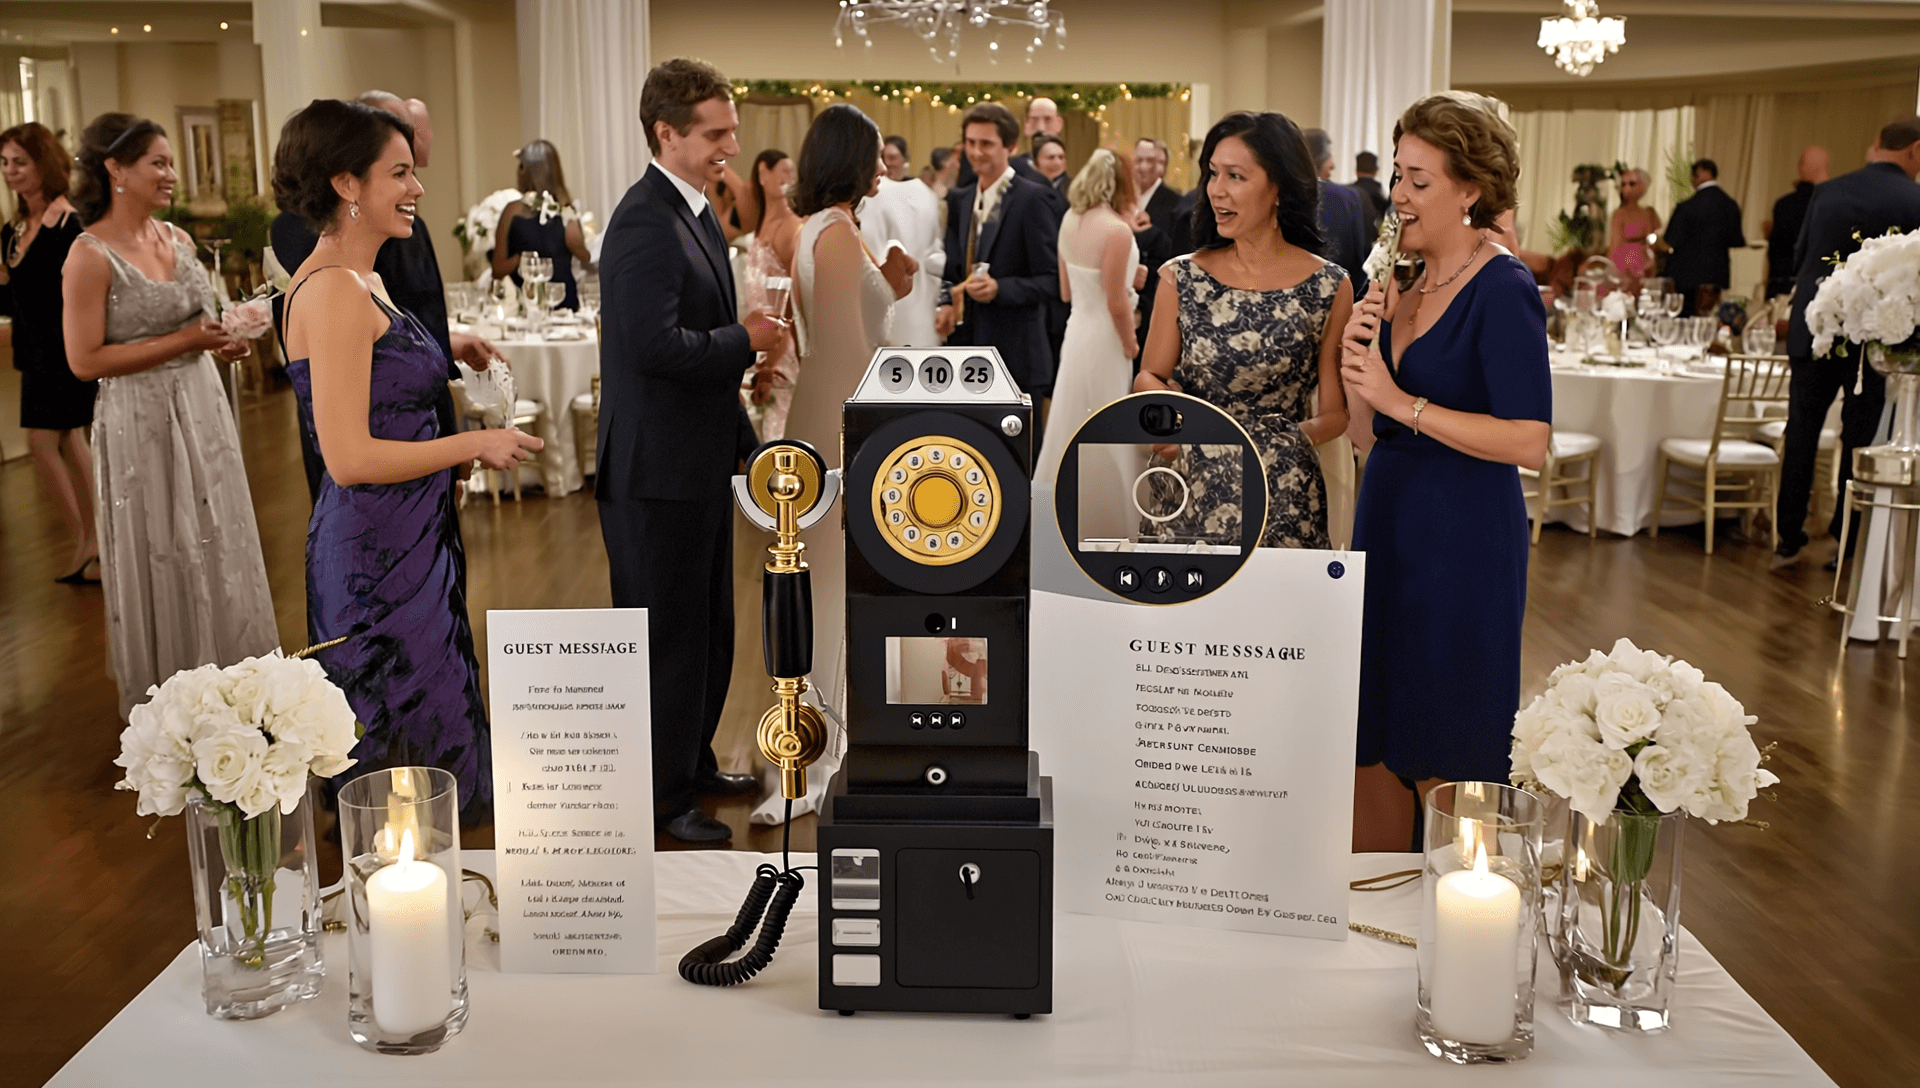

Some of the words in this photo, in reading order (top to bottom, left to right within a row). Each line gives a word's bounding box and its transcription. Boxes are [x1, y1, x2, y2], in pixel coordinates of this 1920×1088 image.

[891, 367, 903, 383] 5
[924, 366, 948, 384] 10
[964, 366, 989, 383] 25
[503, 643, 553, 655] GUEST
[1129, 638, 1197, 656] GUEST
